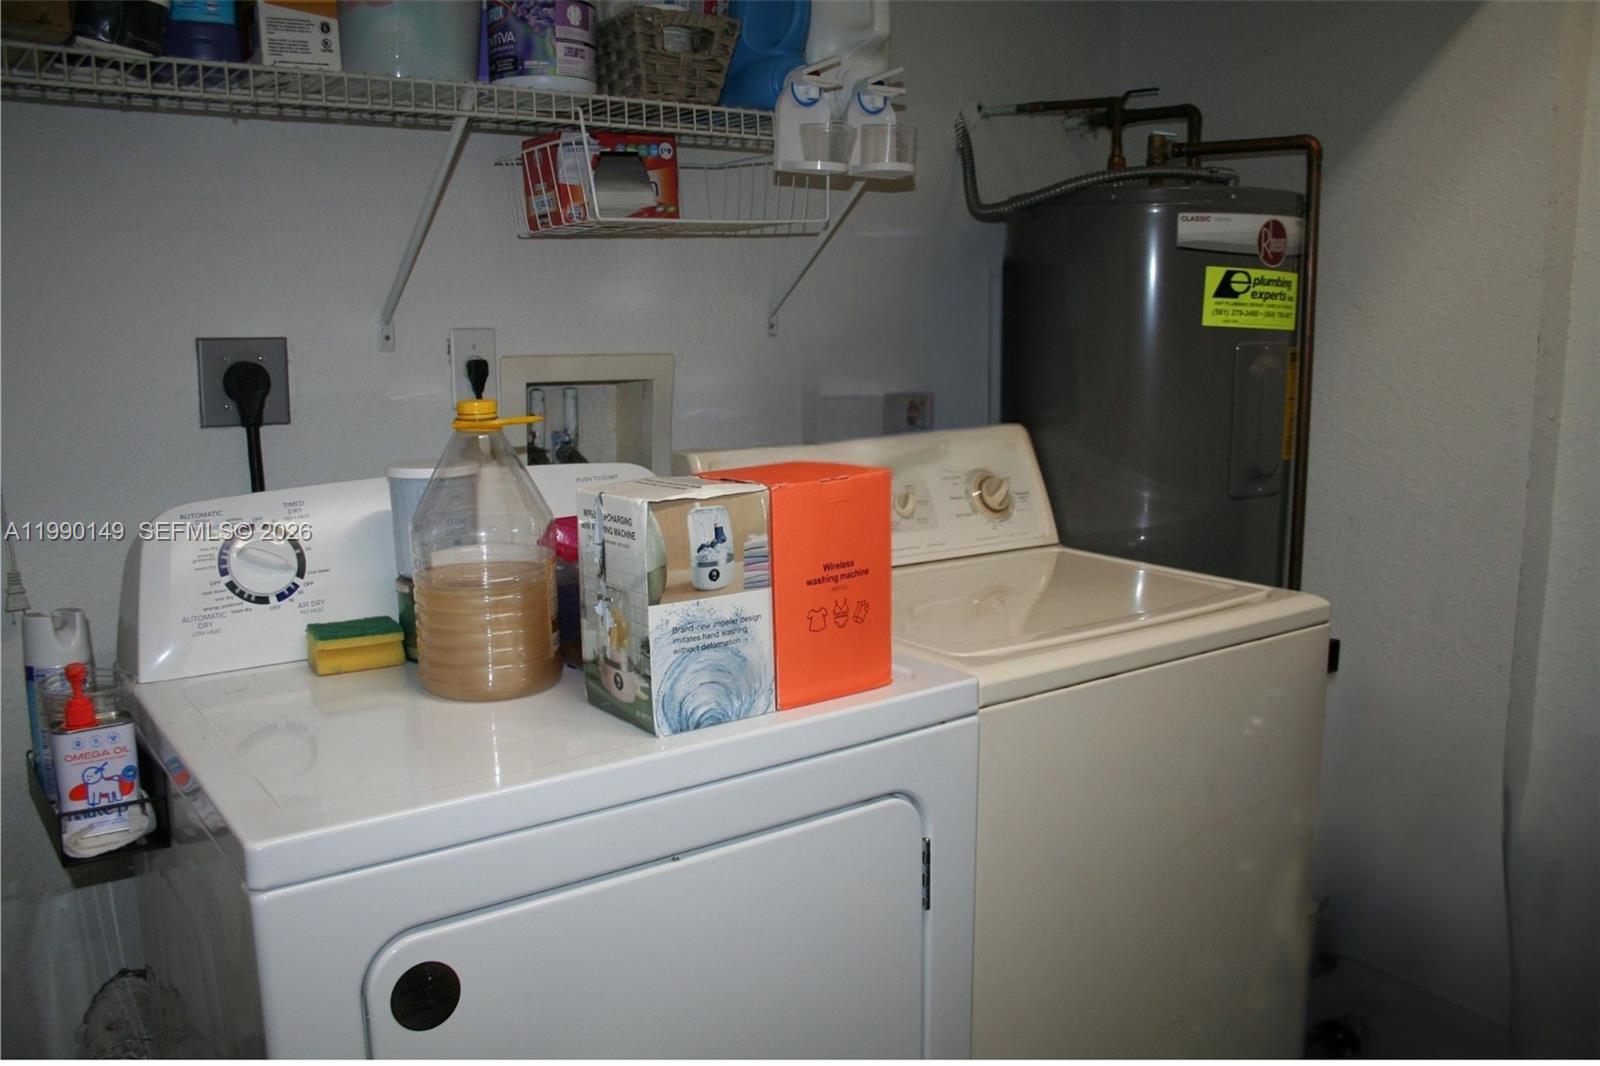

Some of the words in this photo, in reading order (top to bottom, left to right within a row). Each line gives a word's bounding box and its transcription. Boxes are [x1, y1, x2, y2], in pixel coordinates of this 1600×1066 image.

[1252, 275, 1293, 291] plumbing
[1250, 290, 1287, 302] experts
[179, 511, 223, 520] AUTOMATIC
[822, 560, 855, 572] Wireless
[806, 574, 839, 586] washing
[839, 568, 870, 580] machine
[298, 601, 309, 609] AIR
[311, 599, 325, 607] DRY
[182, 612, 227, 623] AUTOMATIC
[672, 623, 711, 635] Brand-new
[739, 613, 762, 624] design
[198, 622, 213, 630] DRY
[673, 635, 701, 644] imitates
[702, 630, 720, 640] hand
[721, 626, 749, 638] washing
[673, 645, 700, 655] without
[700, 638, 741, 651] deformation
[64, 749, 111, 762] OMEGA
[113, 746, 131, 755] OIL
